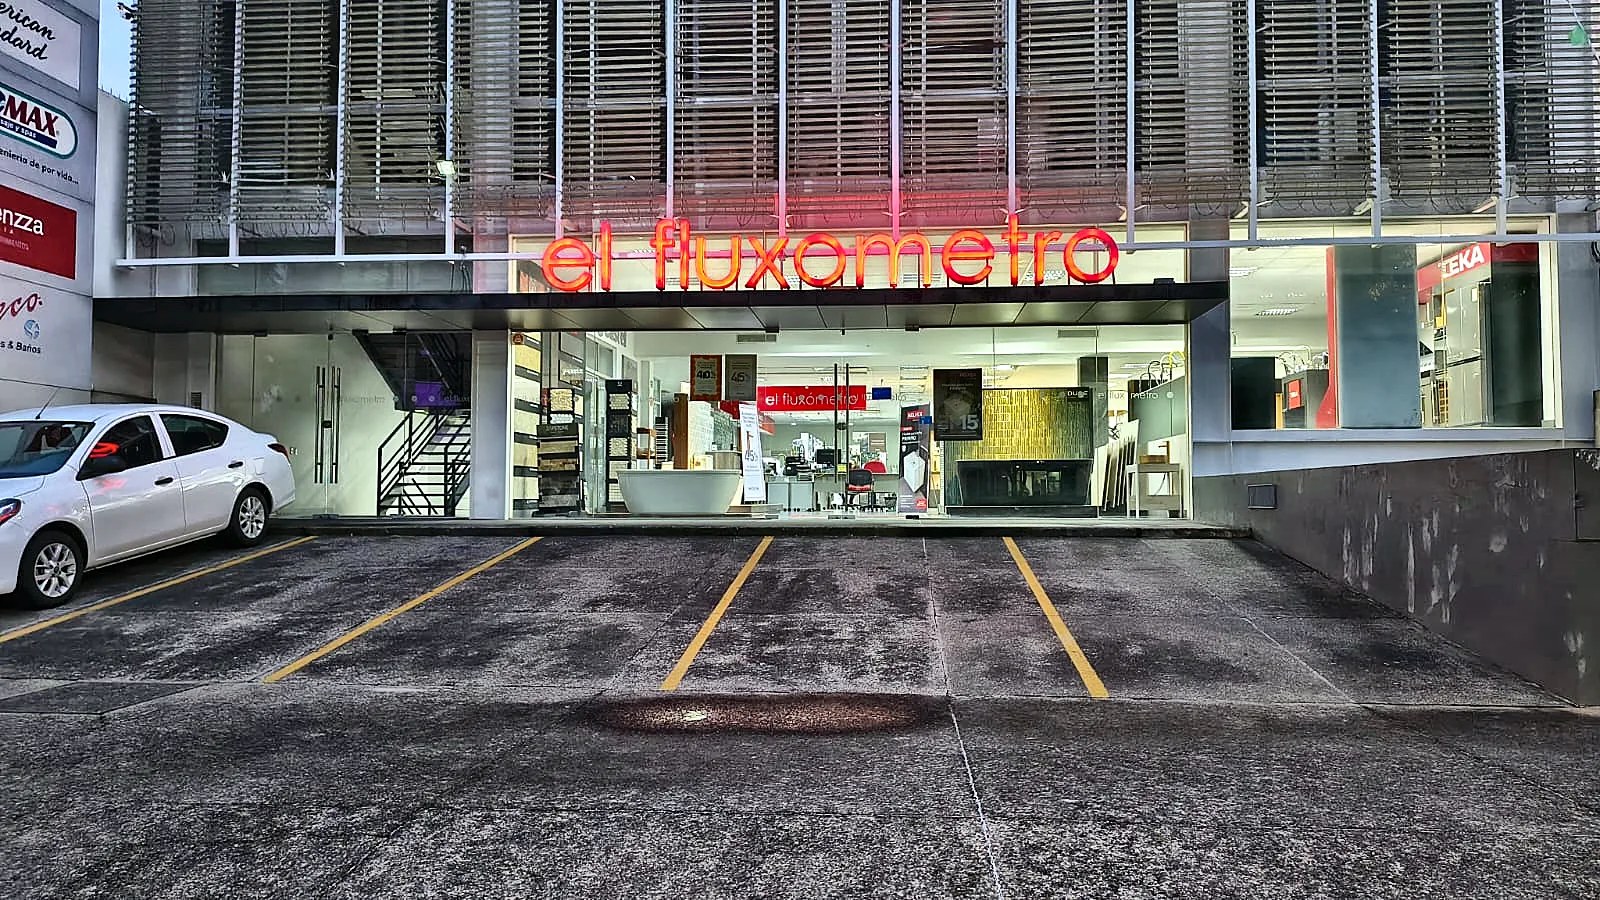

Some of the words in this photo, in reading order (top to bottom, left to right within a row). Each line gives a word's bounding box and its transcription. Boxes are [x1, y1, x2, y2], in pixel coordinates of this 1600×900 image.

[0, 26, 48, 60] dard
[29, 159, 41, 169] de
[41, 165, 56, 174] por
[0, 208, 44, 235] nzza
[542, 220, 613, 291] el
[650, 213, 1120, 291] fluxometro
[1438, 245, 1485, 278] TEKA
